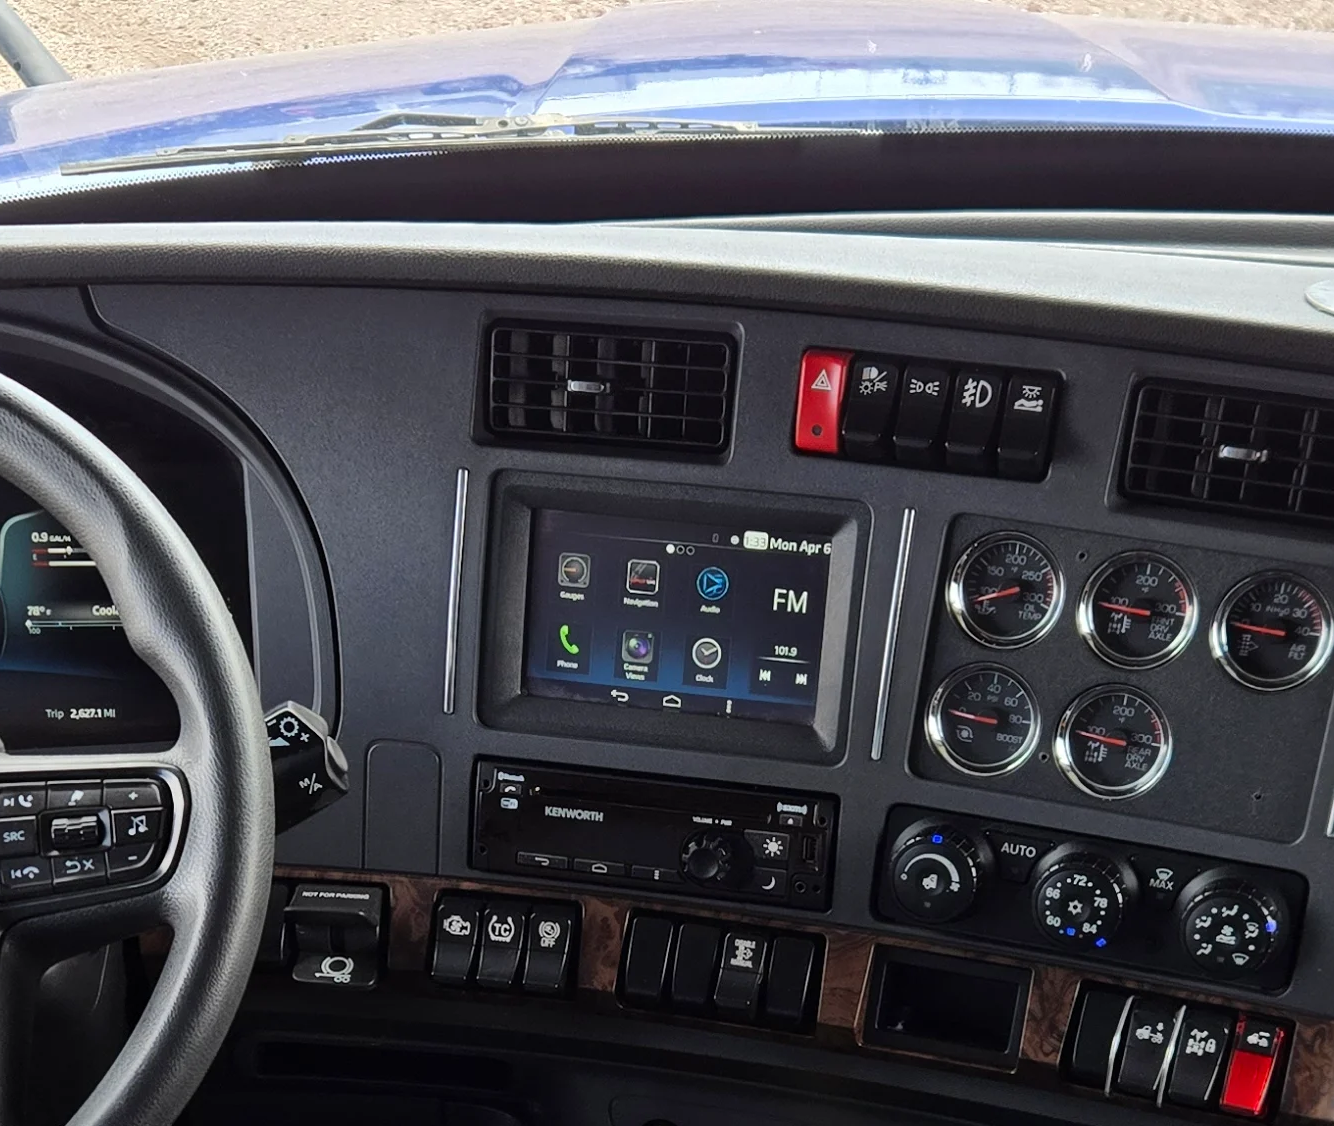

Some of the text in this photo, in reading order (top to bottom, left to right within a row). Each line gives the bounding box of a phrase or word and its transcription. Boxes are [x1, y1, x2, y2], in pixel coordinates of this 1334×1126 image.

[31, 532, 48, 543] 0.9
[769, 537, 798, 550] Mon
[798, 541, 821, 556] Apr
[823, 543, 832, 555] 6
[1005, 553, 1027, 566] 200
[1021, 570, 1043, 582] 250
[1135, 575, 1159, 587] 200
[623, 597, 659, 608] Navigation
[772, 588, 809, 614] FM
[1022, 592, 1044, 603] 300
[1273, 593, 1289, 604] 20
[700, 605, 721, 614] Audio
[1023, 603, 1036, 612] OIL
[1154, 602, 1177, 614] 300
[1249, 602, 1262, 612] 10
[1018, 611, 1042, 620] TEMP
[1292, 607, 1308, 619] 30
[1150, 623, 1170, 634] DRV
[1294, 626, 1311, 637] 40
[1148, 631, 1173, 641] AXLE
[774, 645, 798, 657] 101.9
[1289, 643, 1307, 652] AIR
[1287, 650, 1306, 661] FILT
[557, 660, 578, 669] Phone
[623, 663, 648, 673] Camera
[695, 674, 714, 683] Clock
[987, 683, 1002, 694] 40
[967, 692, 982, 702] 20
[1004, 696, 1019, 707] 60
[45, 708, 65, 720] Trip
[70, 708, 102, 719] 2,627.1
[1112, 705, 1135, 717] 200
[1009, 714, 1023, 725] 80
[996, 732, 1023, 744] BOOST
[1130, 732, 1153, 744] 300
[1127, 745, 1152, 756] REAR
[1126, 753, 1146, 763] DRV
[1124, 761, 1148, 771] AXLE
[298, 772, 323, 794] M/A
[544, 805, 604, 822] KENWORTH
[3, 830, 26, 843] SRC
[1000, 842, 1037, 858] AUTO
[1073, 874, 1088, 886] 72
[1149, 878, 1174, 891] MAX
[319, 891, 335, 899] FOR
[1045, 887, 1061, 899] 66
[1094, 896, 1108, 909] 78
[1046, 915, 1062, 927] 60
[493, 922, 511, 937] TC
[1082, 922, 1098, 934] 84
[540, 937, 556, 948] OFF
